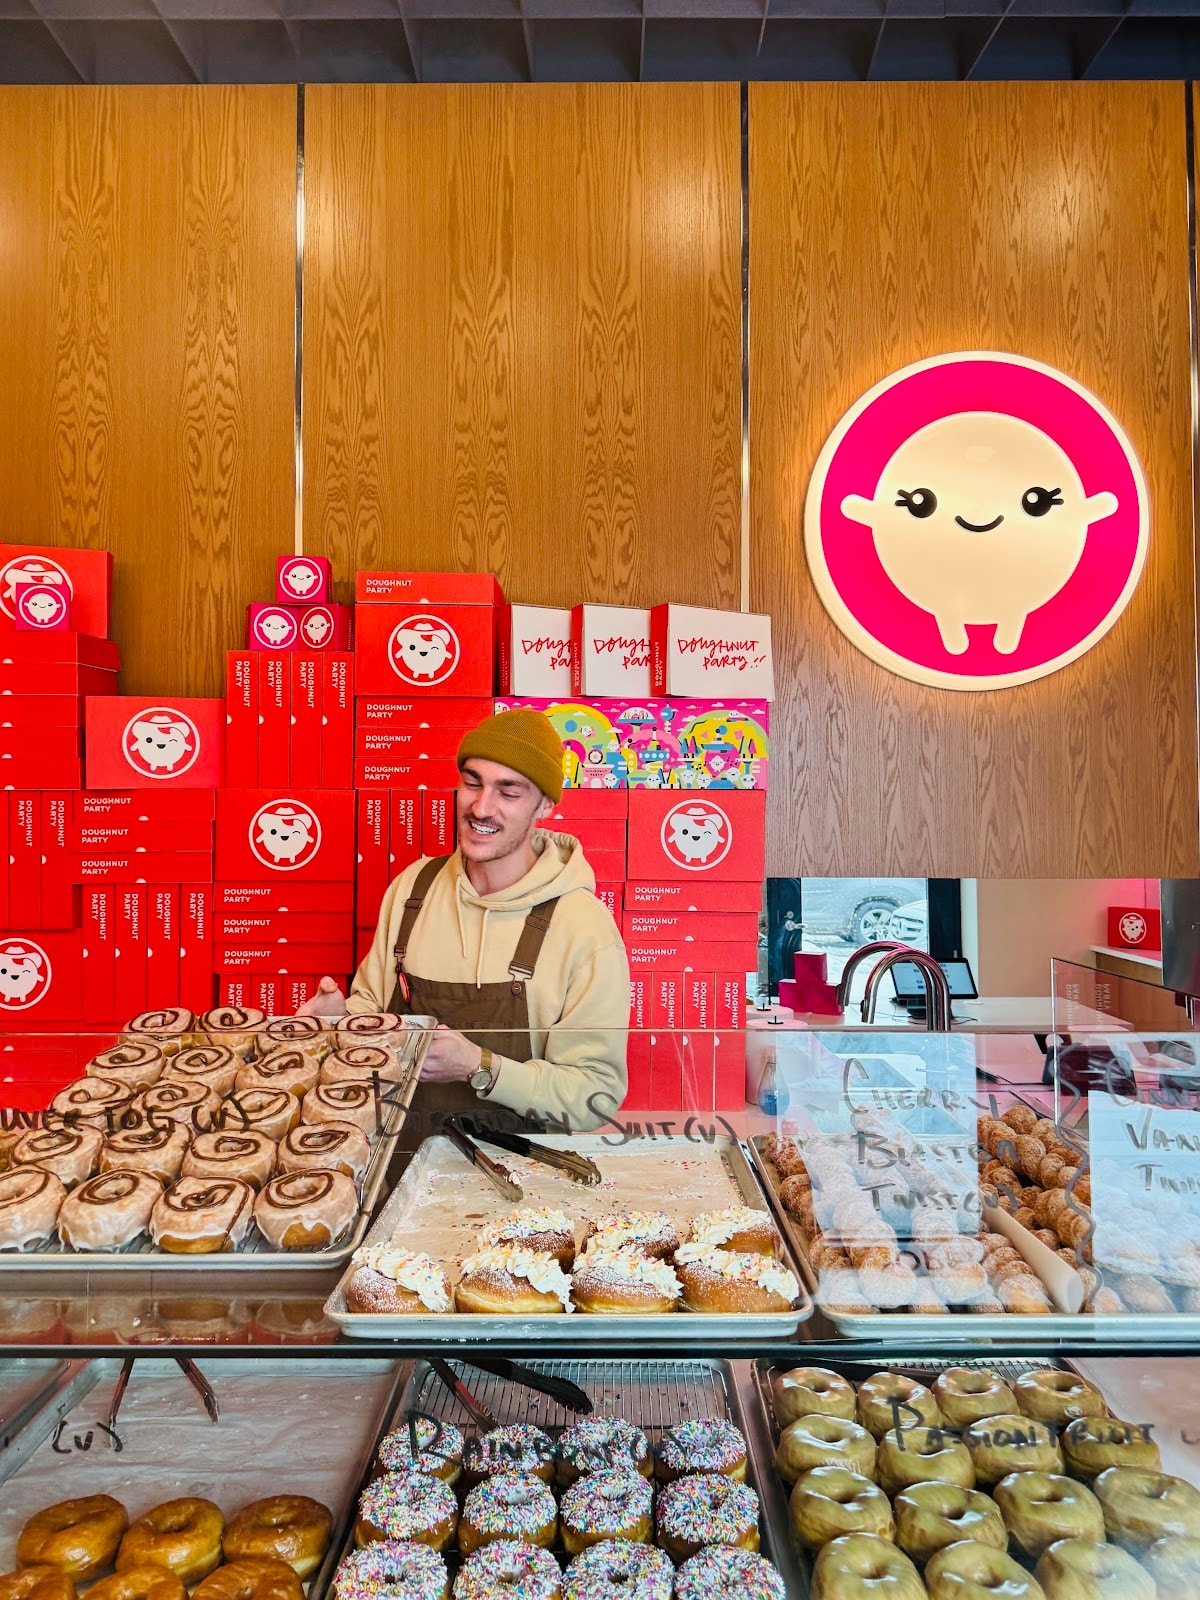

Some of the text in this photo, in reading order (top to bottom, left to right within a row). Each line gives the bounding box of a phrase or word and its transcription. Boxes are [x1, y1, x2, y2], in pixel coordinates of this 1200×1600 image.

[366, 578, 412, 586] DOUGHNUT
[366, 586, 392, 594] PARTY
[234, 660, 242, 687] PARTY
[242, 660, 250, 707] DOUGHNUT
[266, 661, 274, 687] PARTY
[274, 661, 282, 707] DOUGHNUT
[299, 661, 307, 688] PARTY
[306, 661, 314, 708] DOUGHNUT
[330, 661, 338, 688] PARTY
[338, 662, 346, 709] DOUGHNUT
[366, 703, 412, 711] DOUGHNUT
[366, 711, 392, 719] PARTY
[365, 734, 412, 742] DOUGHNUT
[365, 742, 392, 750] PARTY
[364, 765, 411, 773] DOUGHNUT
[364, 773, 391, 781] PARTY
[17, 800, 25, 826] PARTY
[49, 800, 57, 826] PARTY
[84, 797, 131, 805] DOUGHNUT
[84, 804, 111, 812] PARTY
[366, 800, 374, 825] PARTY
[398, 800, 406, 825] PARTY
[430, 800, 438, 825] PARTY
[25, 800, 33, 847] DOUGHNUT
[56, 800, 64, 847] DOUGHNUT
[81, 828, 129, 836] DOUGHNUT
[373, 800, 381, 846] DOUGHNUT
[405, 800, 413, 846] DOUGHNUT
[438, 800, 446, 846] DOUGHNUT
[81, 836, 108, 844] PARTY
[81, 859, 129, 867] DOUGHNUT
[81, 867, 108, 875] PARTY
[224, 888, 271, 896] DOUGHNUT
[224, 895, 251, 903] PARTY
[635, 886, 681, 894] DOUGHNUT
[635, 894, 662, 902] PARTY
[91, 893, 99, 920] PARTY
[98, 893, 106, 940] DOUGHNUT
[123, 893, 131, 920] PARTY
[131, 893, 139, 940] DOUGHNUT
[156, 894, 164, 920] PARTY
[163, 893, 171, 940] DOUGHNUT
[189, 893, 197, 920] PARTY
[196, 893, 204, 940] DOUGHNUT
[224, 918, 270, 926] DOUGHNUT
[224, 926, 250, 934] PARTY
[632, 917, 678, 925] DOUGHNUT
[632, 925, 658, 933] PARTY
[224, 950, 271, 958] DOUGHNUT
[224, 957, 250, 965] PARTY
[631, 948, 677, 956] DOUGHNUT
[631, 956, 657, 964] PARTY
[227, 984, 235, 1006] PART
[235, 984, 243, 1006] DOUG
[259, 983, 267, 1009] PARTY
[266, 983, 274, 1016] DOUGH
[291, 983, 299, 1009] PARTY
[299, 983, 307, 1007] DOUG
[636, 982, 644, 1028] DOUGHNUT
[660, 982, 668, 1008] PARTY
[667, 982, 675, 1028] DOUGHNUT
[693, 982, 701, 1008] PARTY
[700, 982, 708, 1028] DOUGHNUT
[724, 982, 732, 1009] PARTY
[731, 982, 739, 1028] DOUGHNUT
[842, 1057, 1001, 1122] CHERRY
[586, 1091, 676, 1147] SUIT
